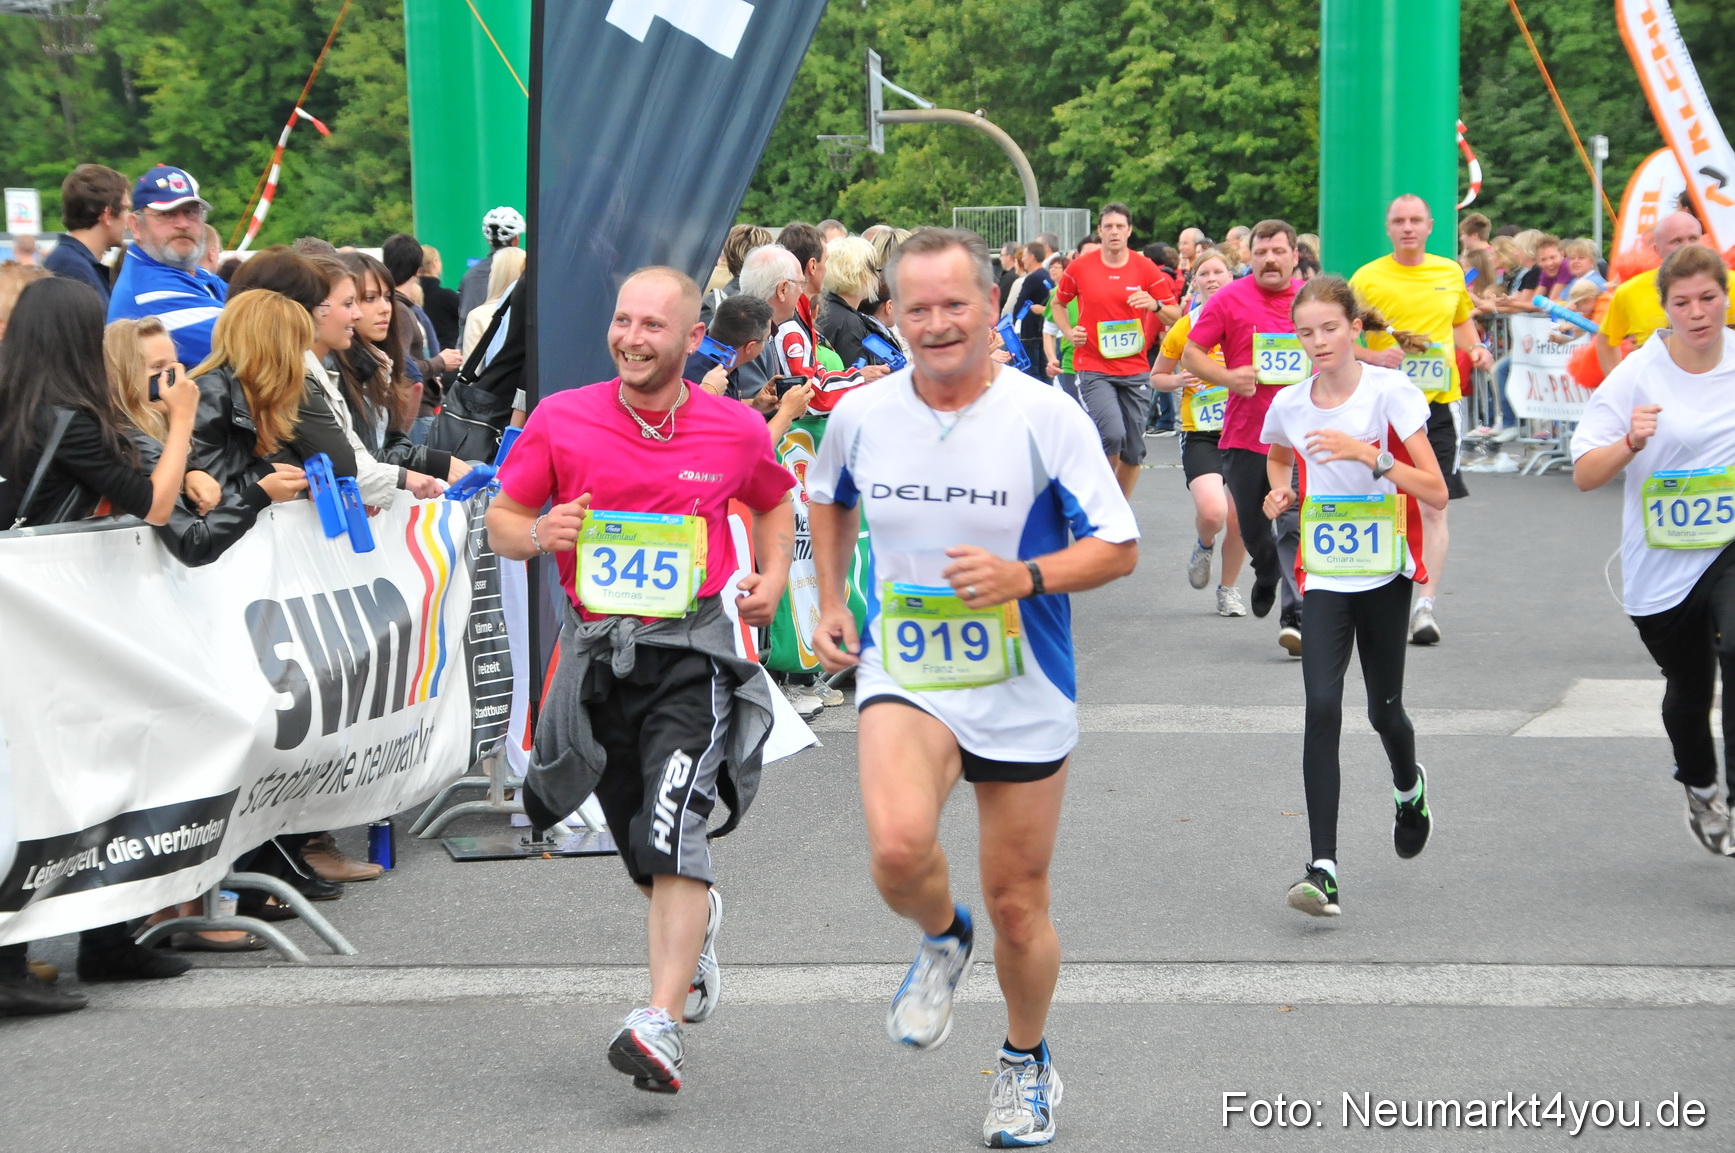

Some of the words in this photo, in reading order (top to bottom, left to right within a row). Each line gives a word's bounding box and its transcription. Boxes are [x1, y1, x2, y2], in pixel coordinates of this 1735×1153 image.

[1101, 332, 1138, 348] 1157
[1260, 351, 1302, 371] 352
[1199, 401, 1227, 424] 45
[871, 483, 1008, 507] DELPHI
[1649, 495, 1735, 527] 1025
[1313, 522, 1379, 555] 631
[591, 546, 679, 591] 345
[1326, 555, 1355, 564] Chiara
[601, 588, 643, 600] Thomas
[897, 620, 990, 663] 919
[922, 664, 954, 674] Franz
[106, 835, 146, 865] die
[144, 818, 226, 857] verbinden
